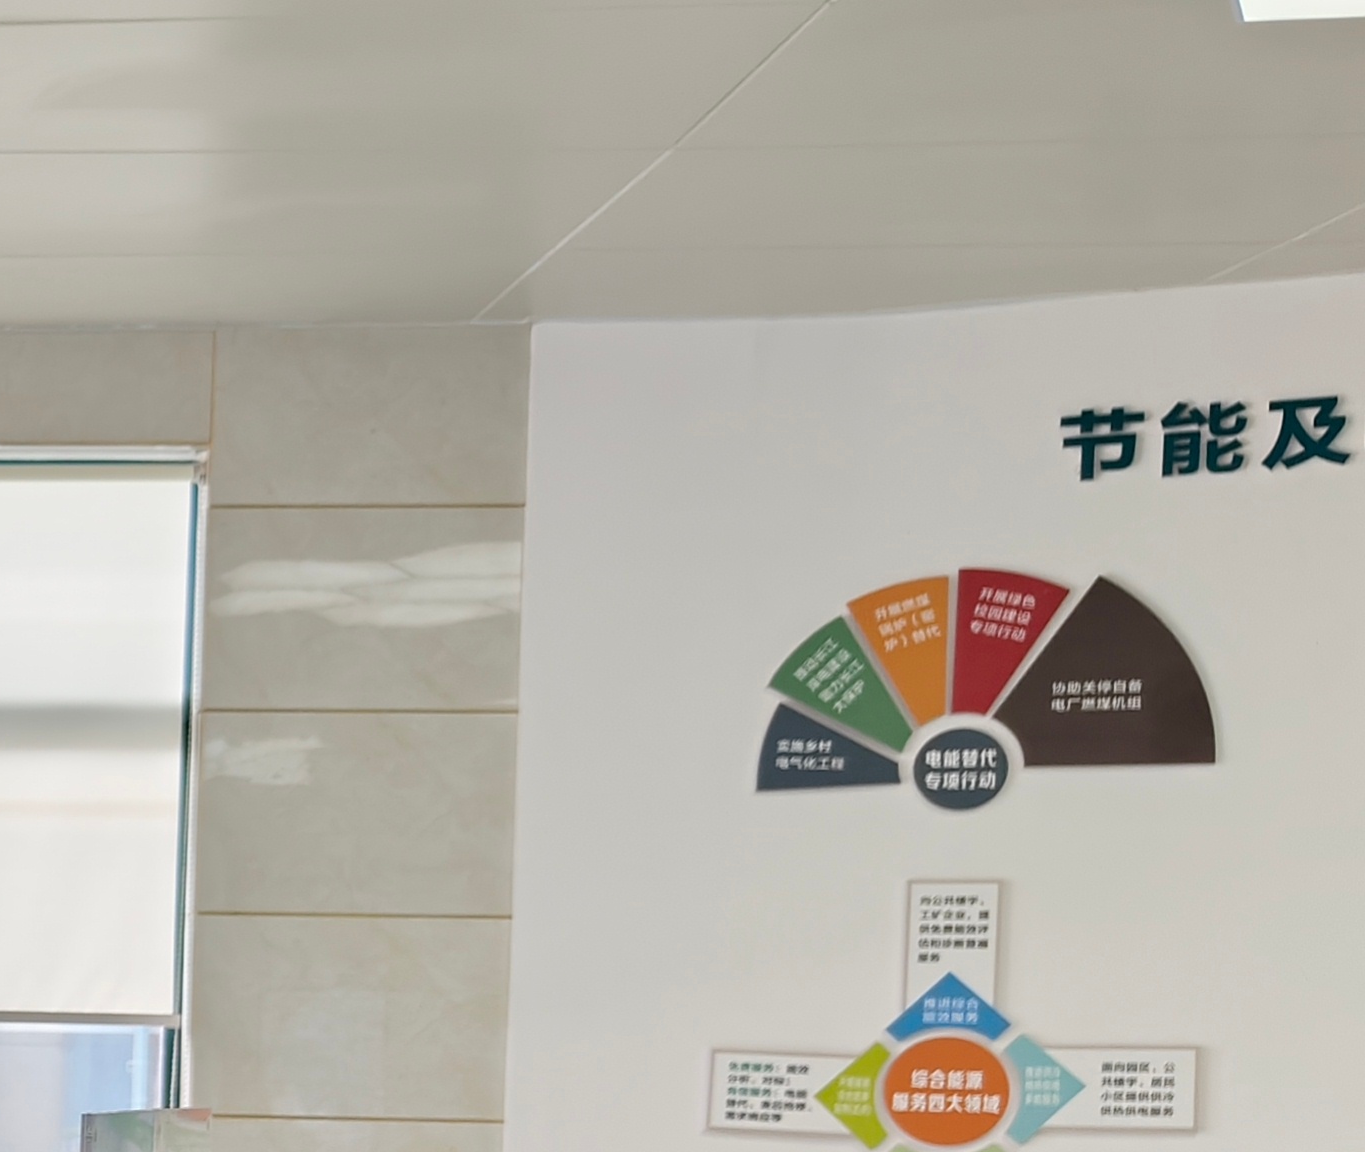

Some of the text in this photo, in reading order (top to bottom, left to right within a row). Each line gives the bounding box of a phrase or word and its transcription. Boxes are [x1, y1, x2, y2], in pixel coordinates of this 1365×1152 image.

[1060, 395, 1351, 481] 节能及
[978, 586, 1036, 608] 开展绿色
[974, 603, 1032, 626] 校园建设
[969, 619, 1026, 642] 专项行动
[1052, 678, 1143, 697] 协助关停自备
[1051, 695, 1143, 712] 电厂燃煤机组
[776, 739, 833, 754] 实施乡村
[925, 748, 998, 769] 电能替代
[924, 770, 997, 791] 专项行动
[910, 1068, 985, 1090] 综合能源
[892, 1091, 1001, 1115] 服务四大领域
